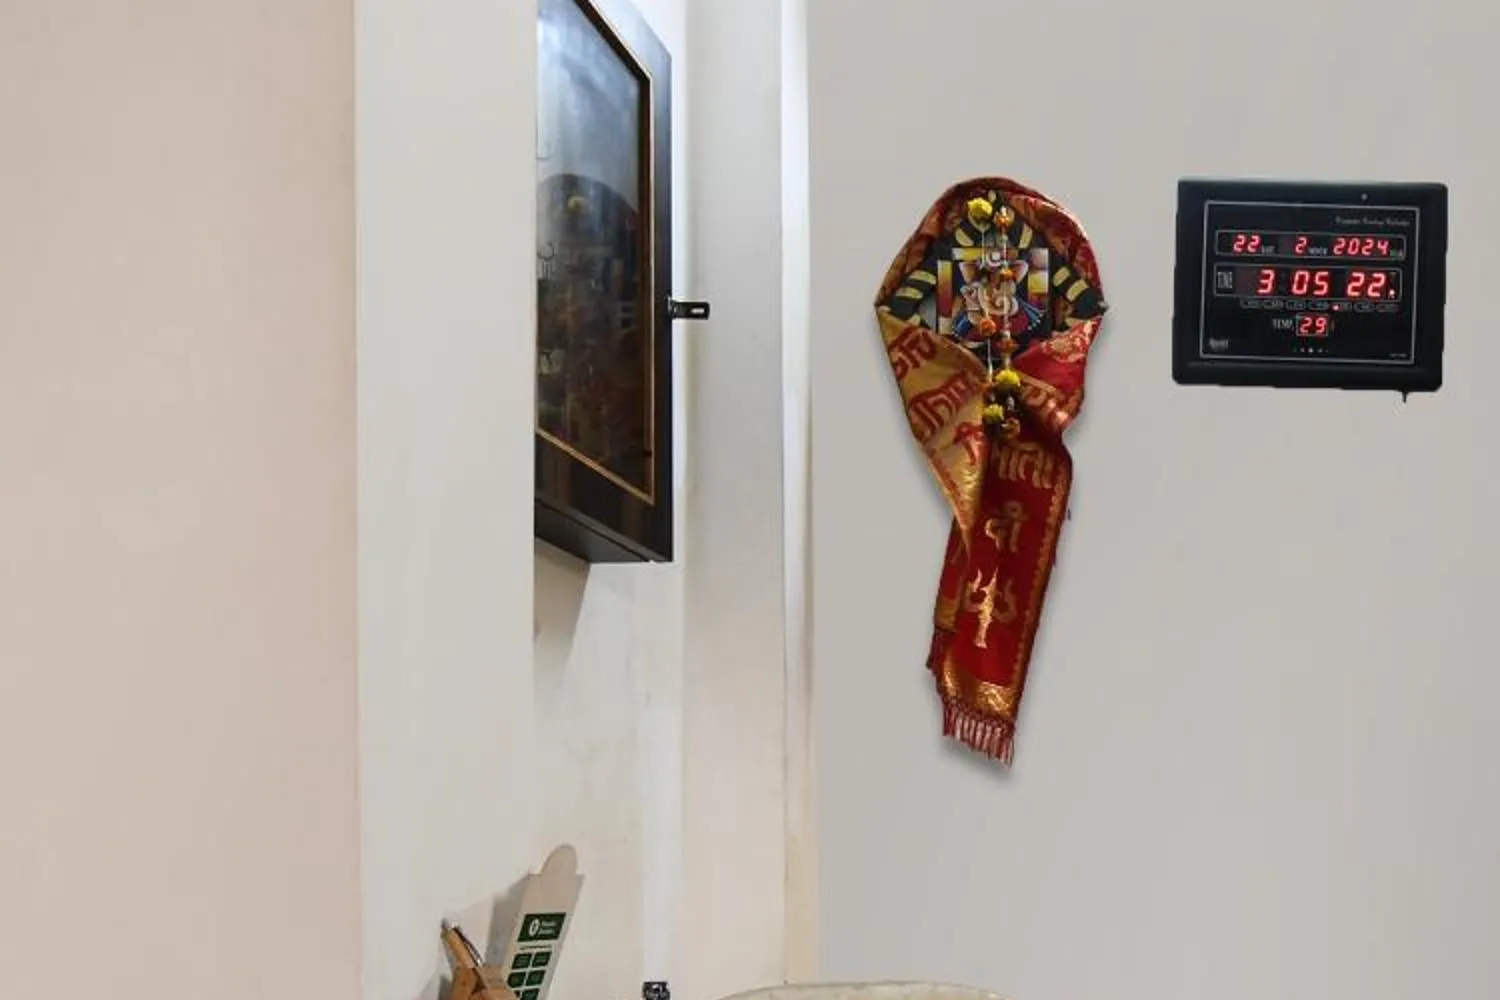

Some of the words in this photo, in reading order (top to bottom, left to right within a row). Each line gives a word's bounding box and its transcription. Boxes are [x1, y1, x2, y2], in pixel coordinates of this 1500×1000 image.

[1233, 235, 1261, 253] 22
[1295, 237, 1308, 253] 2
[1333, 237, 1389, 255] 2024
[1256, 269, 1276, 294] 3
[1291, 270, 1330, 296] 05
[1300, 317, 1326, 333] 29
